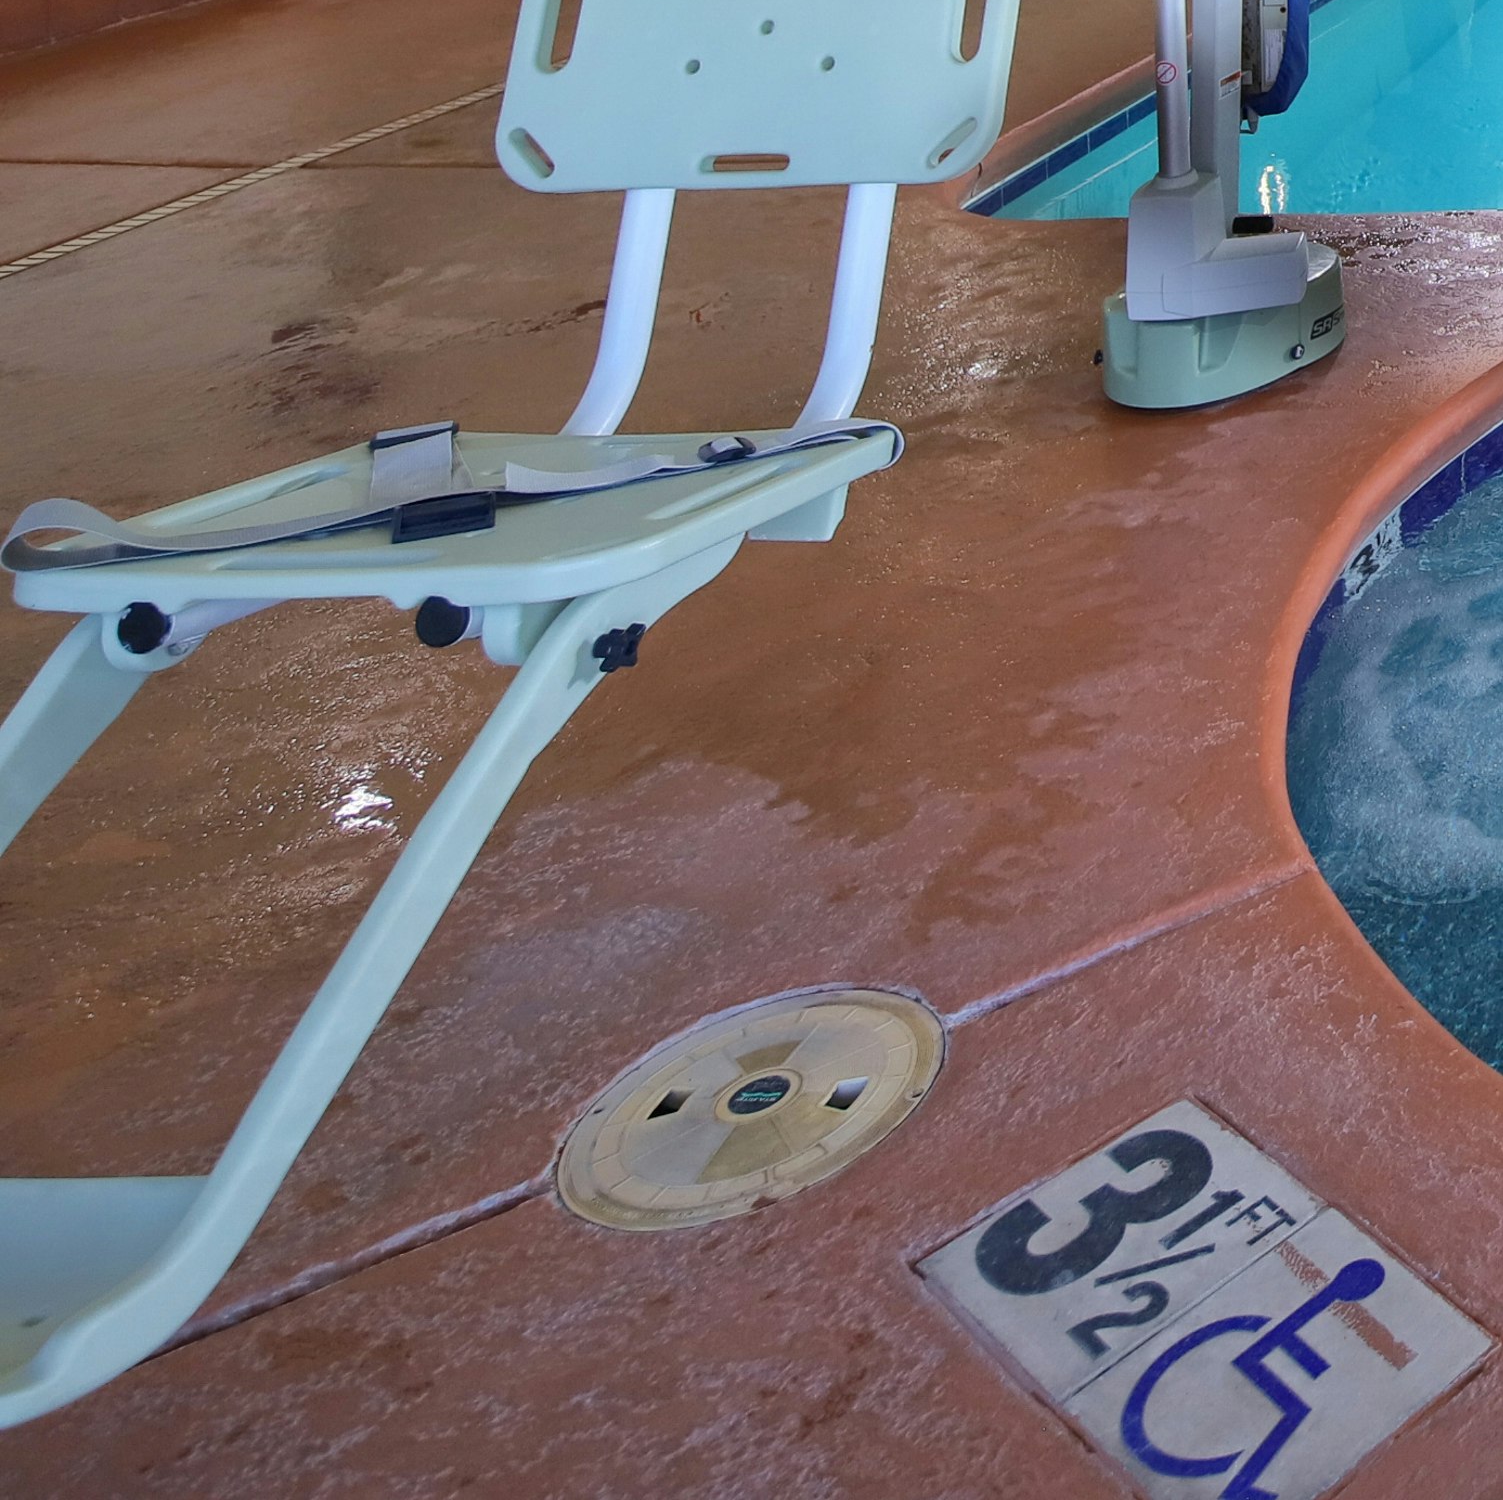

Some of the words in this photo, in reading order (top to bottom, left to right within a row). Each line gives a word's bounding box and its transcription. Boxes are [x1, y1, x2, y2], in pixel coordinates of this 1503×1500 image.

[1312, 316, 1332, 337] SR
[975, 1129, 1213, 1296] 3
[1226, 1195, 1297, 1246] FT
